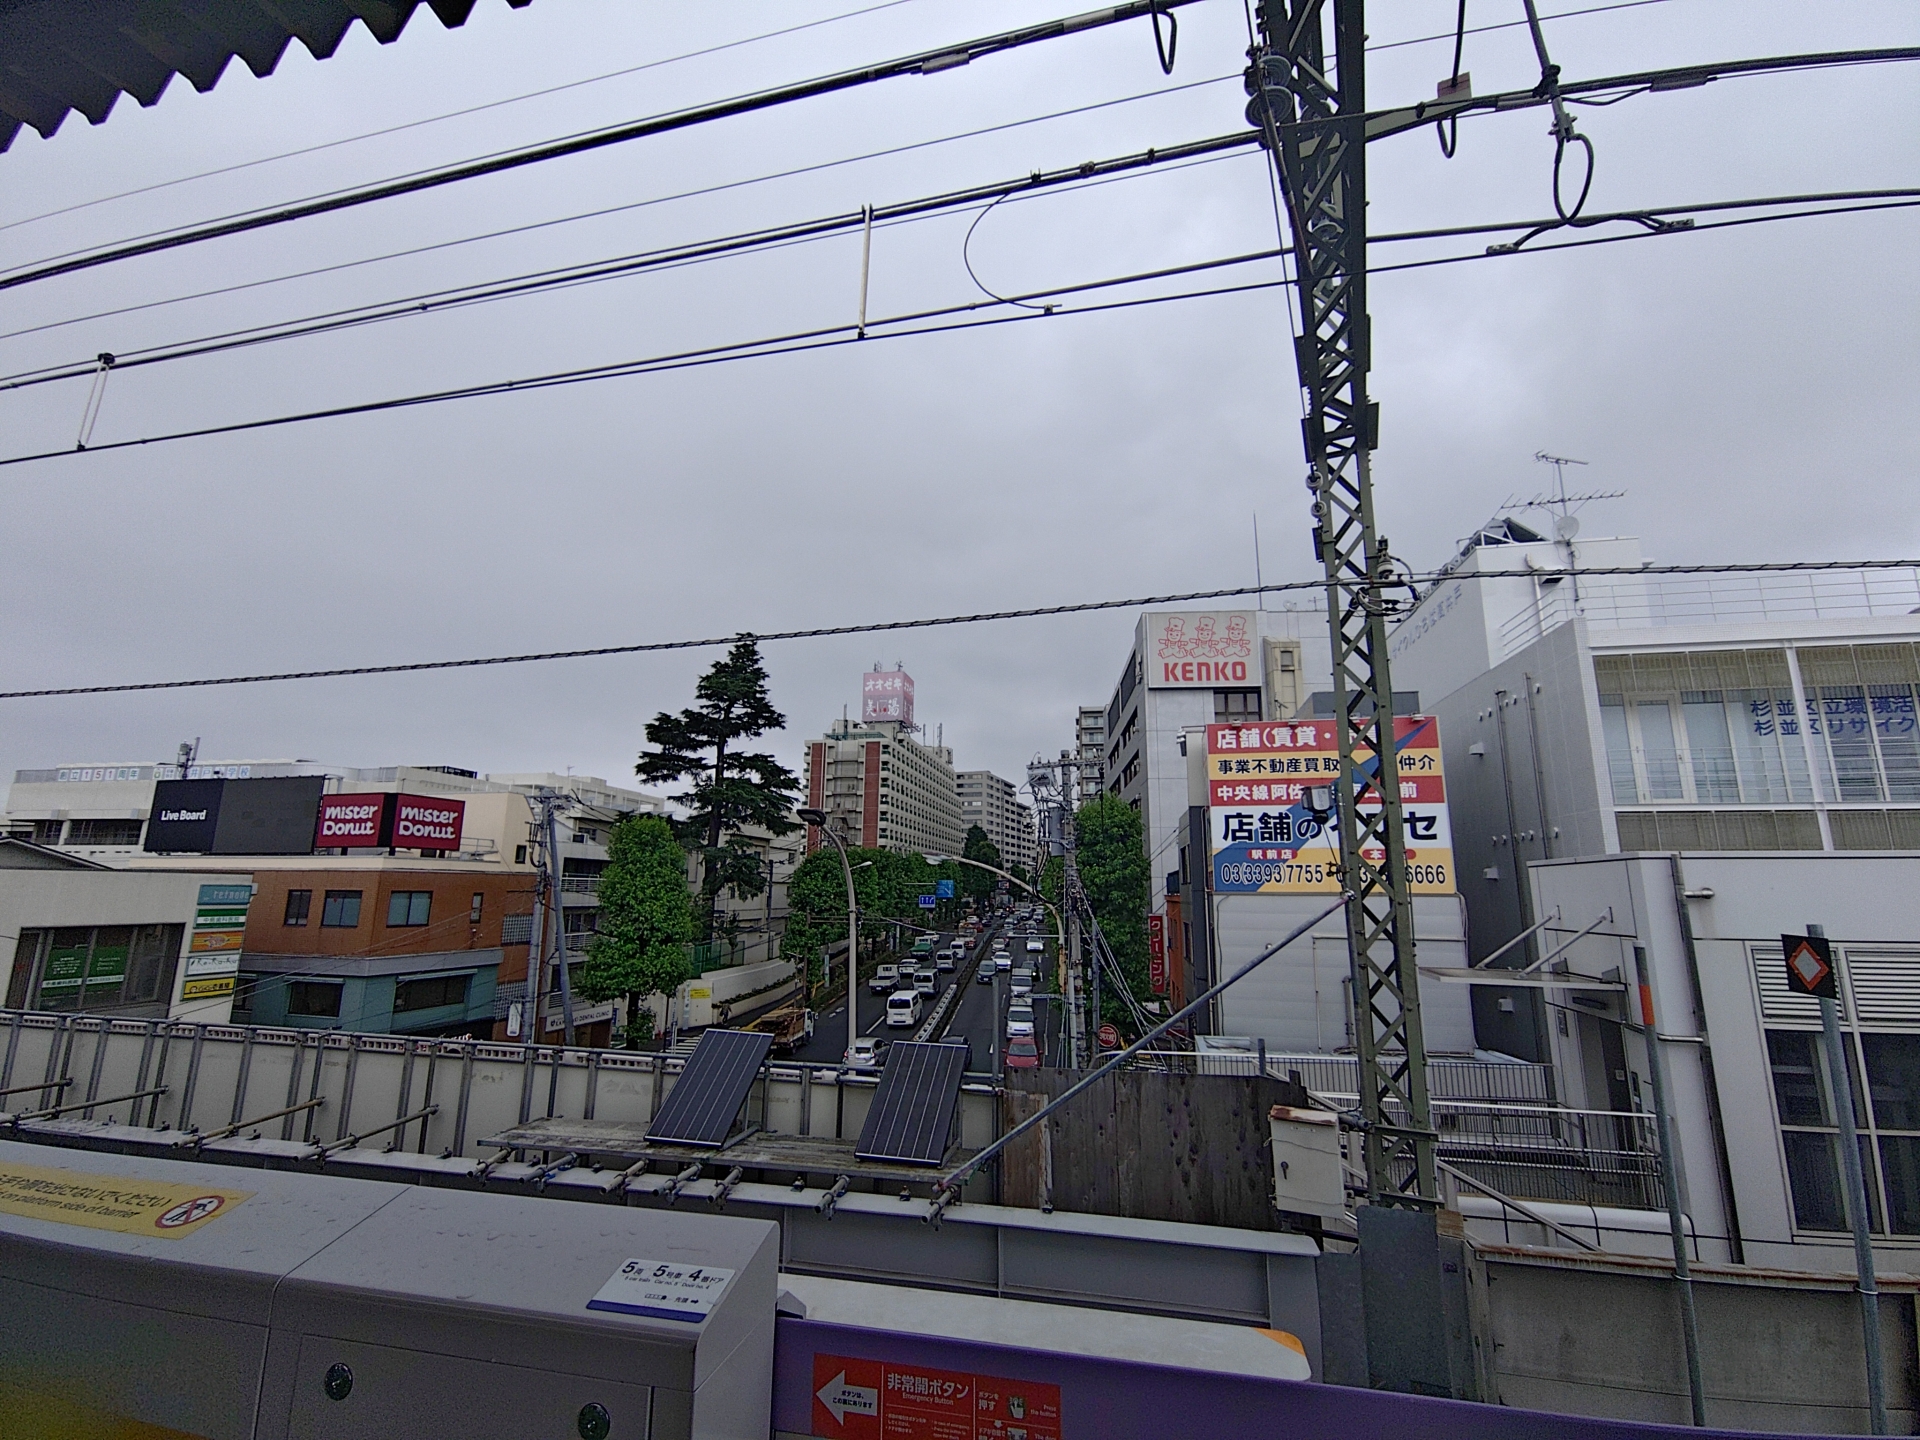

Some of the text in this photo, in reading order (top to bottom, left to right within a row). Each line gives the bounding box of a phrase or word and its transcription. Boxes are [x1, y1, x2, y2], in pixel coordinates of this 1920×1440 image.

[1164, 661, 1247, 682] KENKO
[865, 677, 902, 691] オオゼキ
[1217, 753, 1436, 775] 事業不動産買取 仲介
[161, 810, 207, 821] Live Board
[322, 821, 375, 836] Donut
[398, 821, 456, 839] Donut
[1222, 811, 1438, 843] 店舗のセ
[1251, 849, 1293, 860] 駅前店
[1221, 864, 1324, 885] 03(3393)7755
[59, 1202, 86, 1211] side
[84, 1204, 100, 1213] of
[98, 1206, 140, 1218] barrier
[887, 1372, 969, 1399] 非常開ボタン
[902, 1392, 954, 1406] Emergency Button
[978, 1399, 996, 1411] 押す
